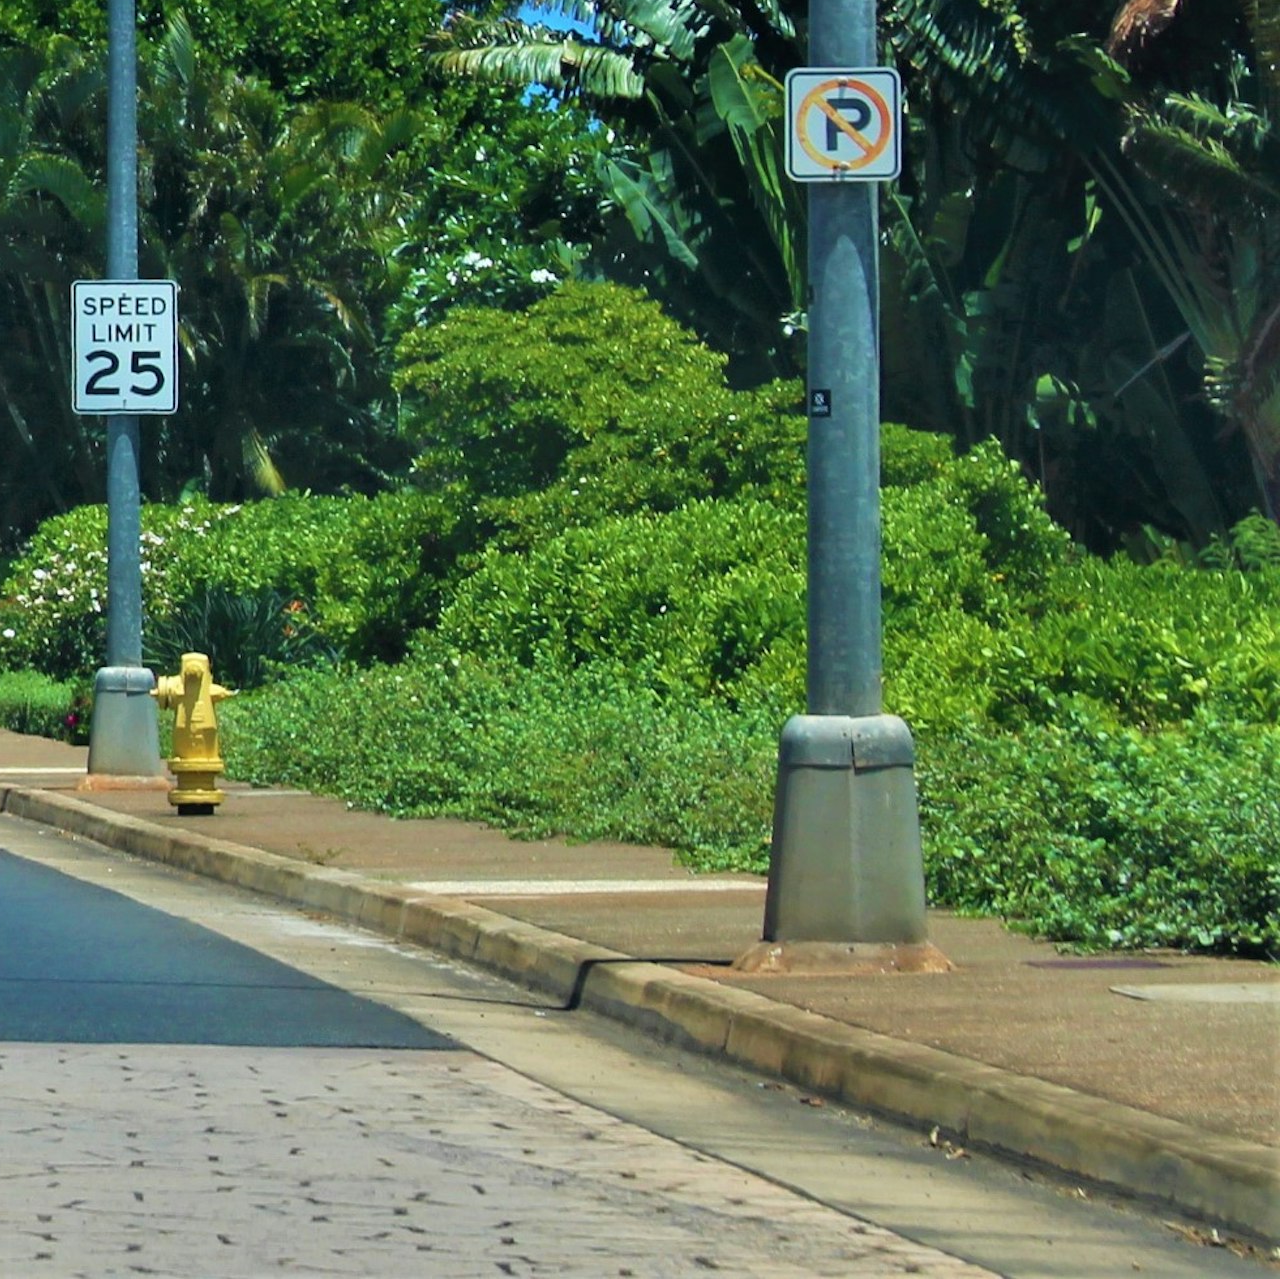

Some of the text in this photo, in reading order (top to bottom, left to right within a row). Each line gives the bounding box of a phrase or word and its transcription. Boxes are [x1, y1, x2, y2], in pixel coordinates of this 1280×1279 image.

[826, 98, 871, 151] P
[83, 297, 166, 316] SPEED
[92, 323, 157, 343] LIMIT
[85, 350, 165, 396] 25
